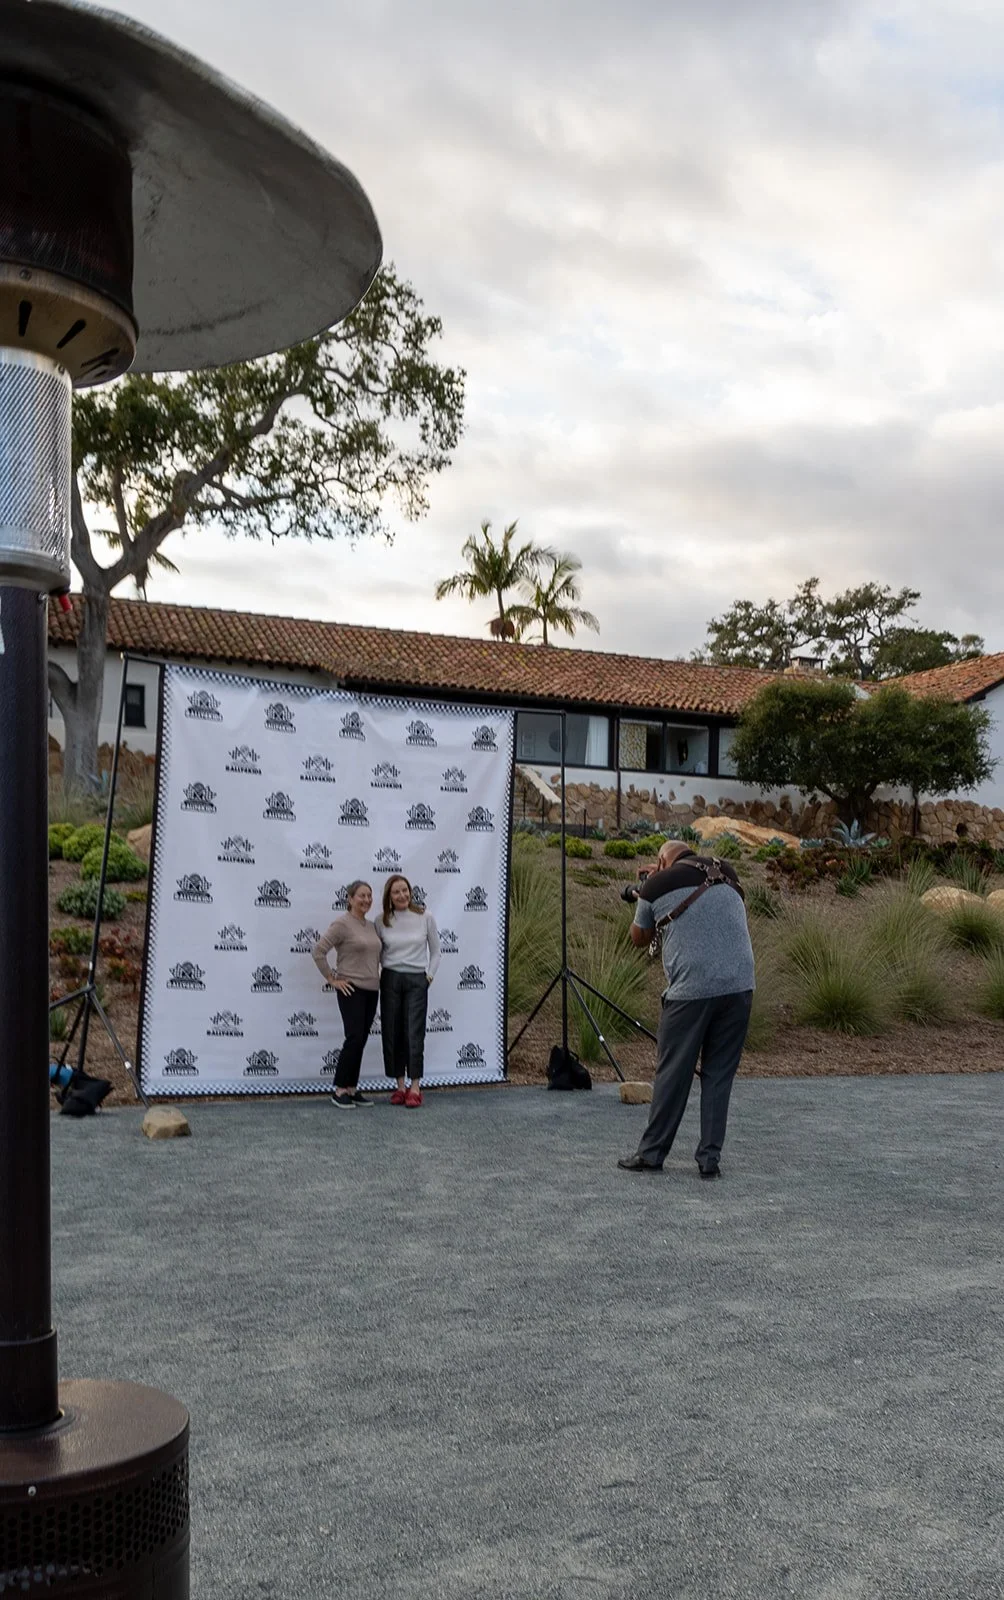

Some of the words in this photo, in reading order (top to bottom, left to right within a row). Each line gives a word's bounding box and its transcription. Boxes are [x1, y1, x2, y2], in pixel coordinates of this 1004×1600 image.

[225, 766, 262, 775] RALLY4KIDS
[300, 775, 336, 783] RALLY4KIDS
[218, 856, 255, 865] RALLY4KIDS
[207, 1030, 244, 1038] RALLY4KIDS
